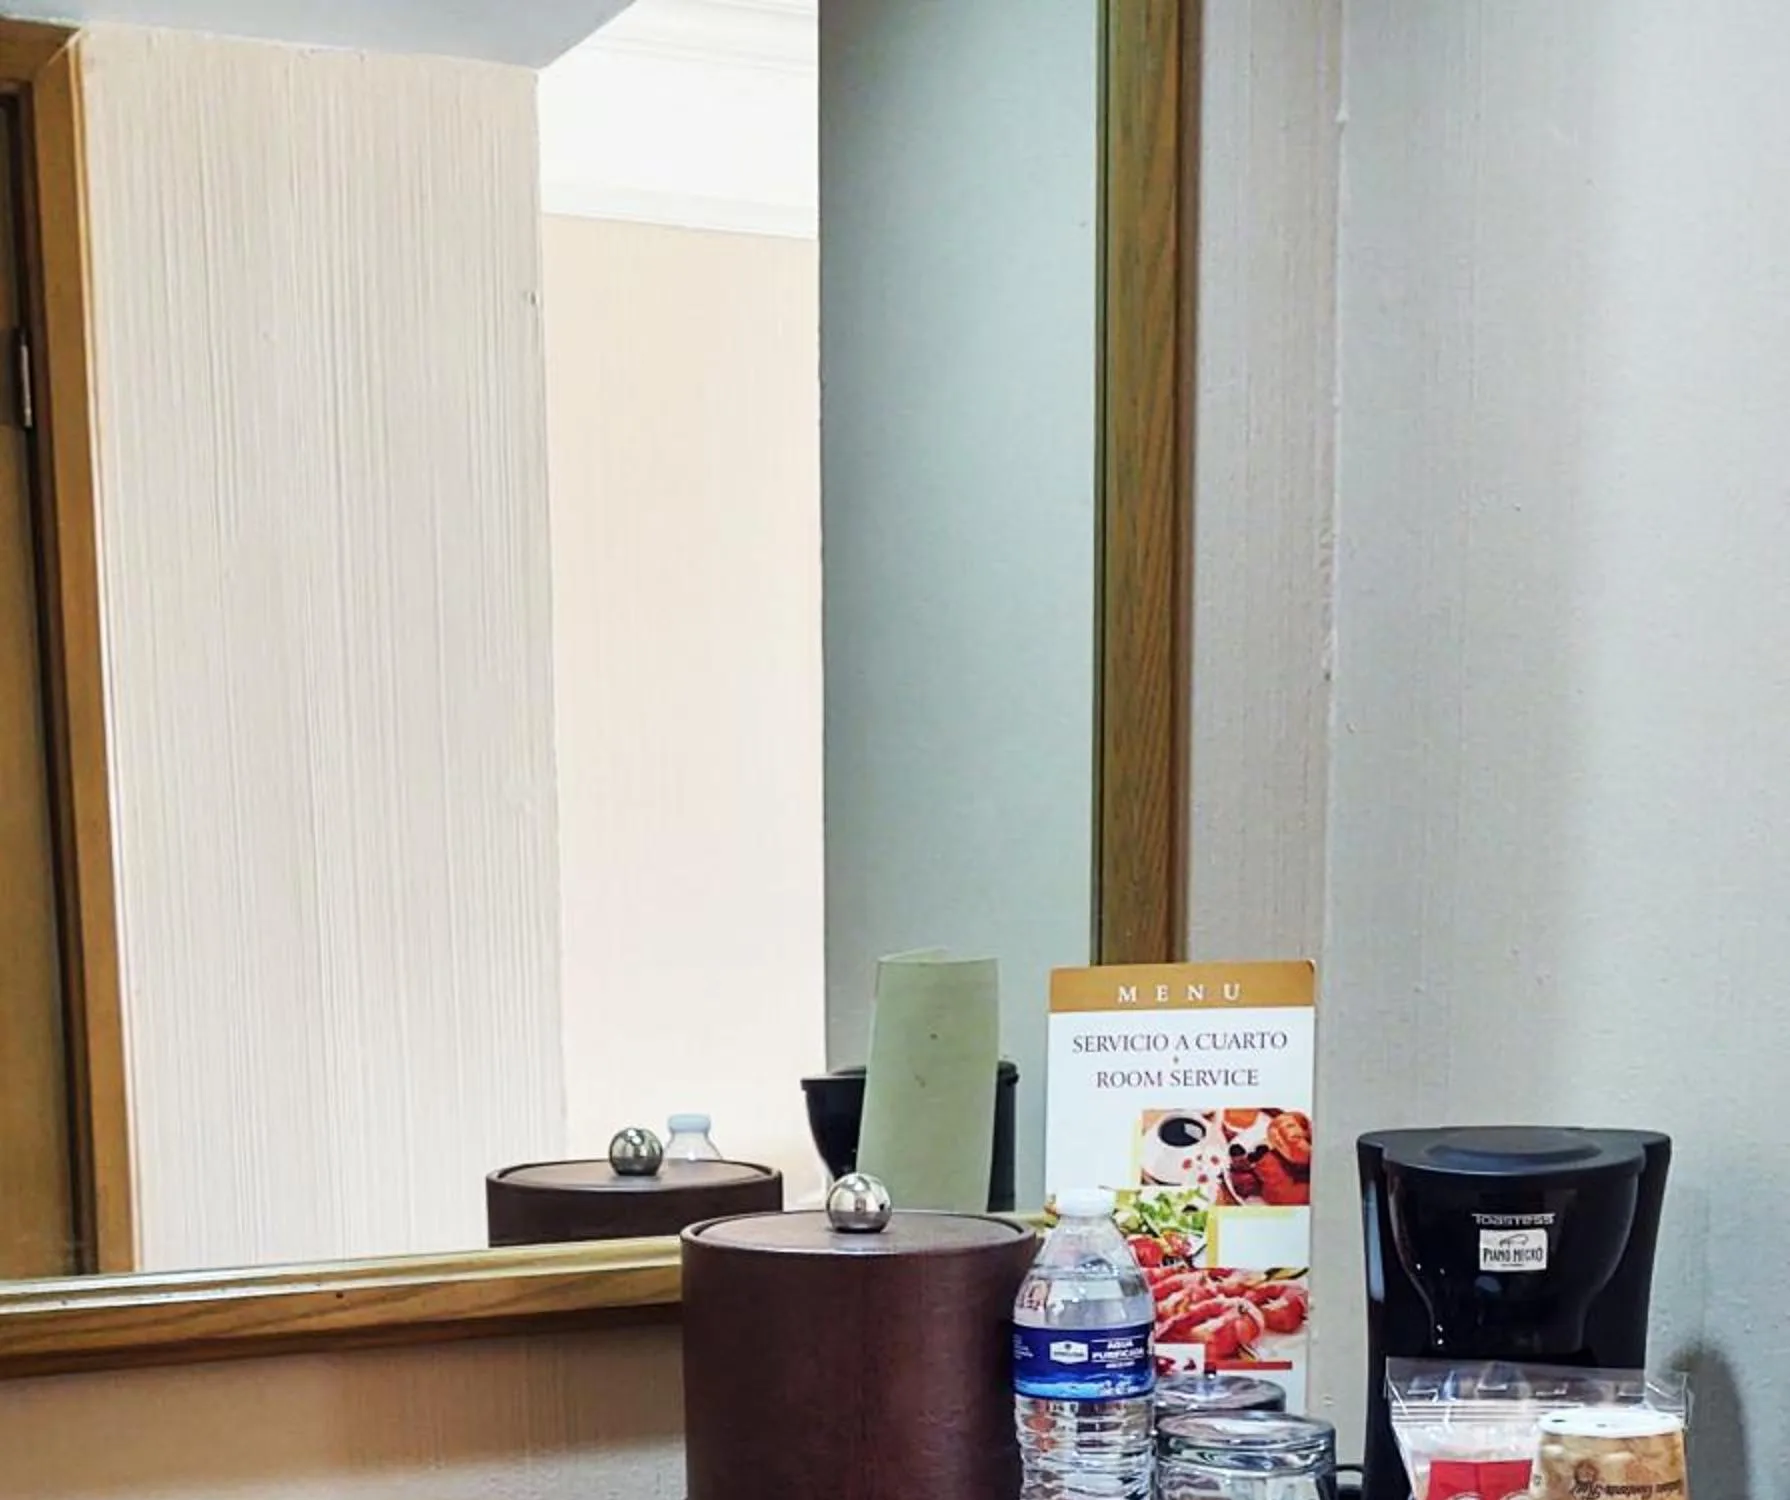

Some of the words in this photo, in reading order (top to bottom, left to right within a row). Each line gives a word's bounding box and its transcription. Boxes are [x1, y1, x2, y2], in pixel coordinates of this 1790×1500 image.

[1117, 984, 1241, 1003] MENU
[1072, 1034, 1169, 1053] SERVICIO
[1174, 1034, 1190, 1051] A
[1195, 1031, 1288, 1051] CUARTO
[1096, 1071, 1164, 1089] ROOM
[1169, 1069, 1260, 1088] SERVICE
